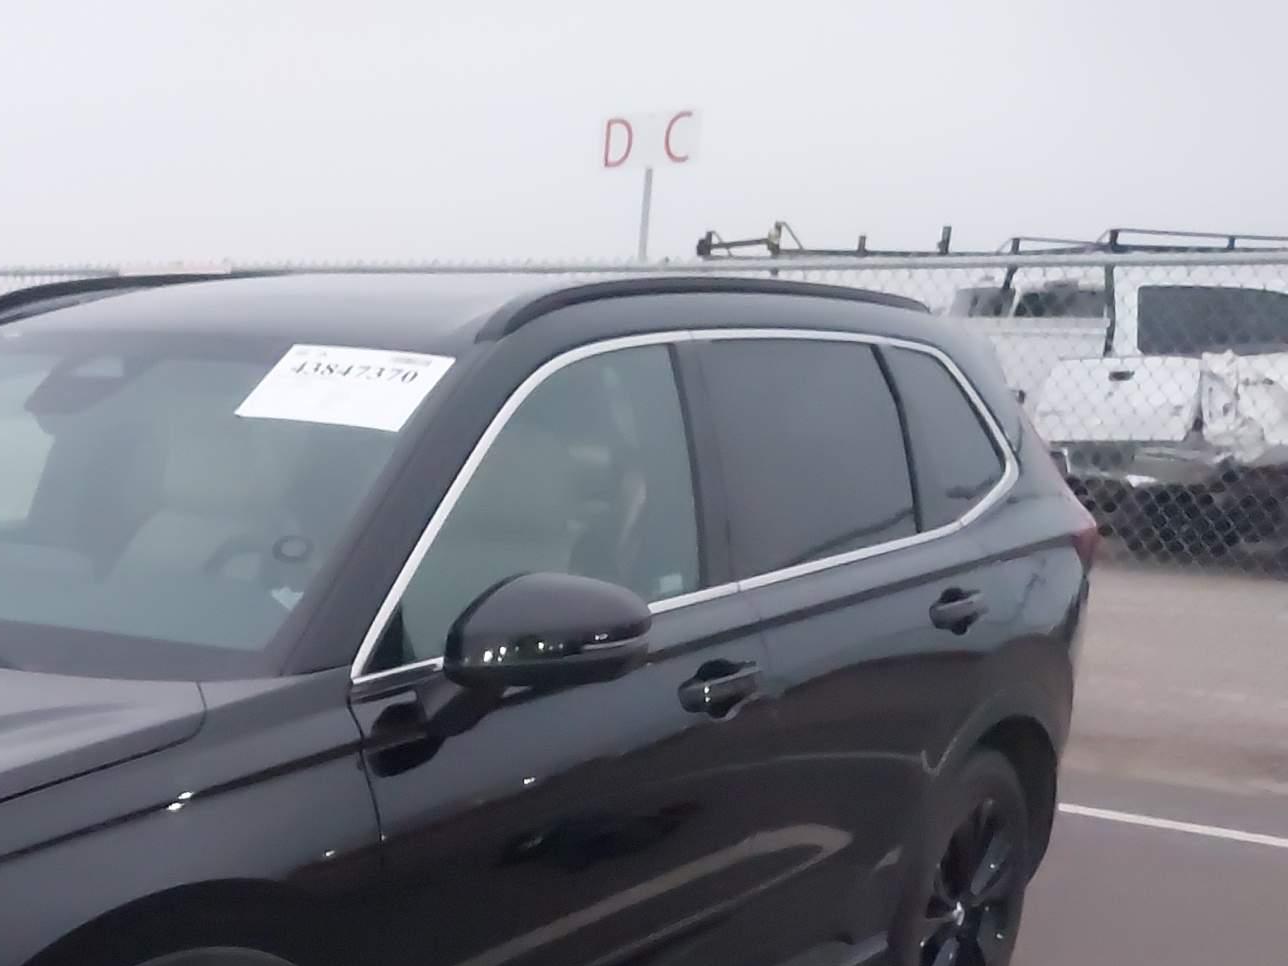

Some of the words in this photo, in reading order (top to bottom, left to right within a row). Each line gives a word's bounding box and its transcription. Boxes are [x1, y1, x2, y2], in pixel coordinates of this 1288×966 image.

[604, 118, 633, 168] D
[665, 110, 693, 163] C
[291, 361, 419, 383] 43847370
